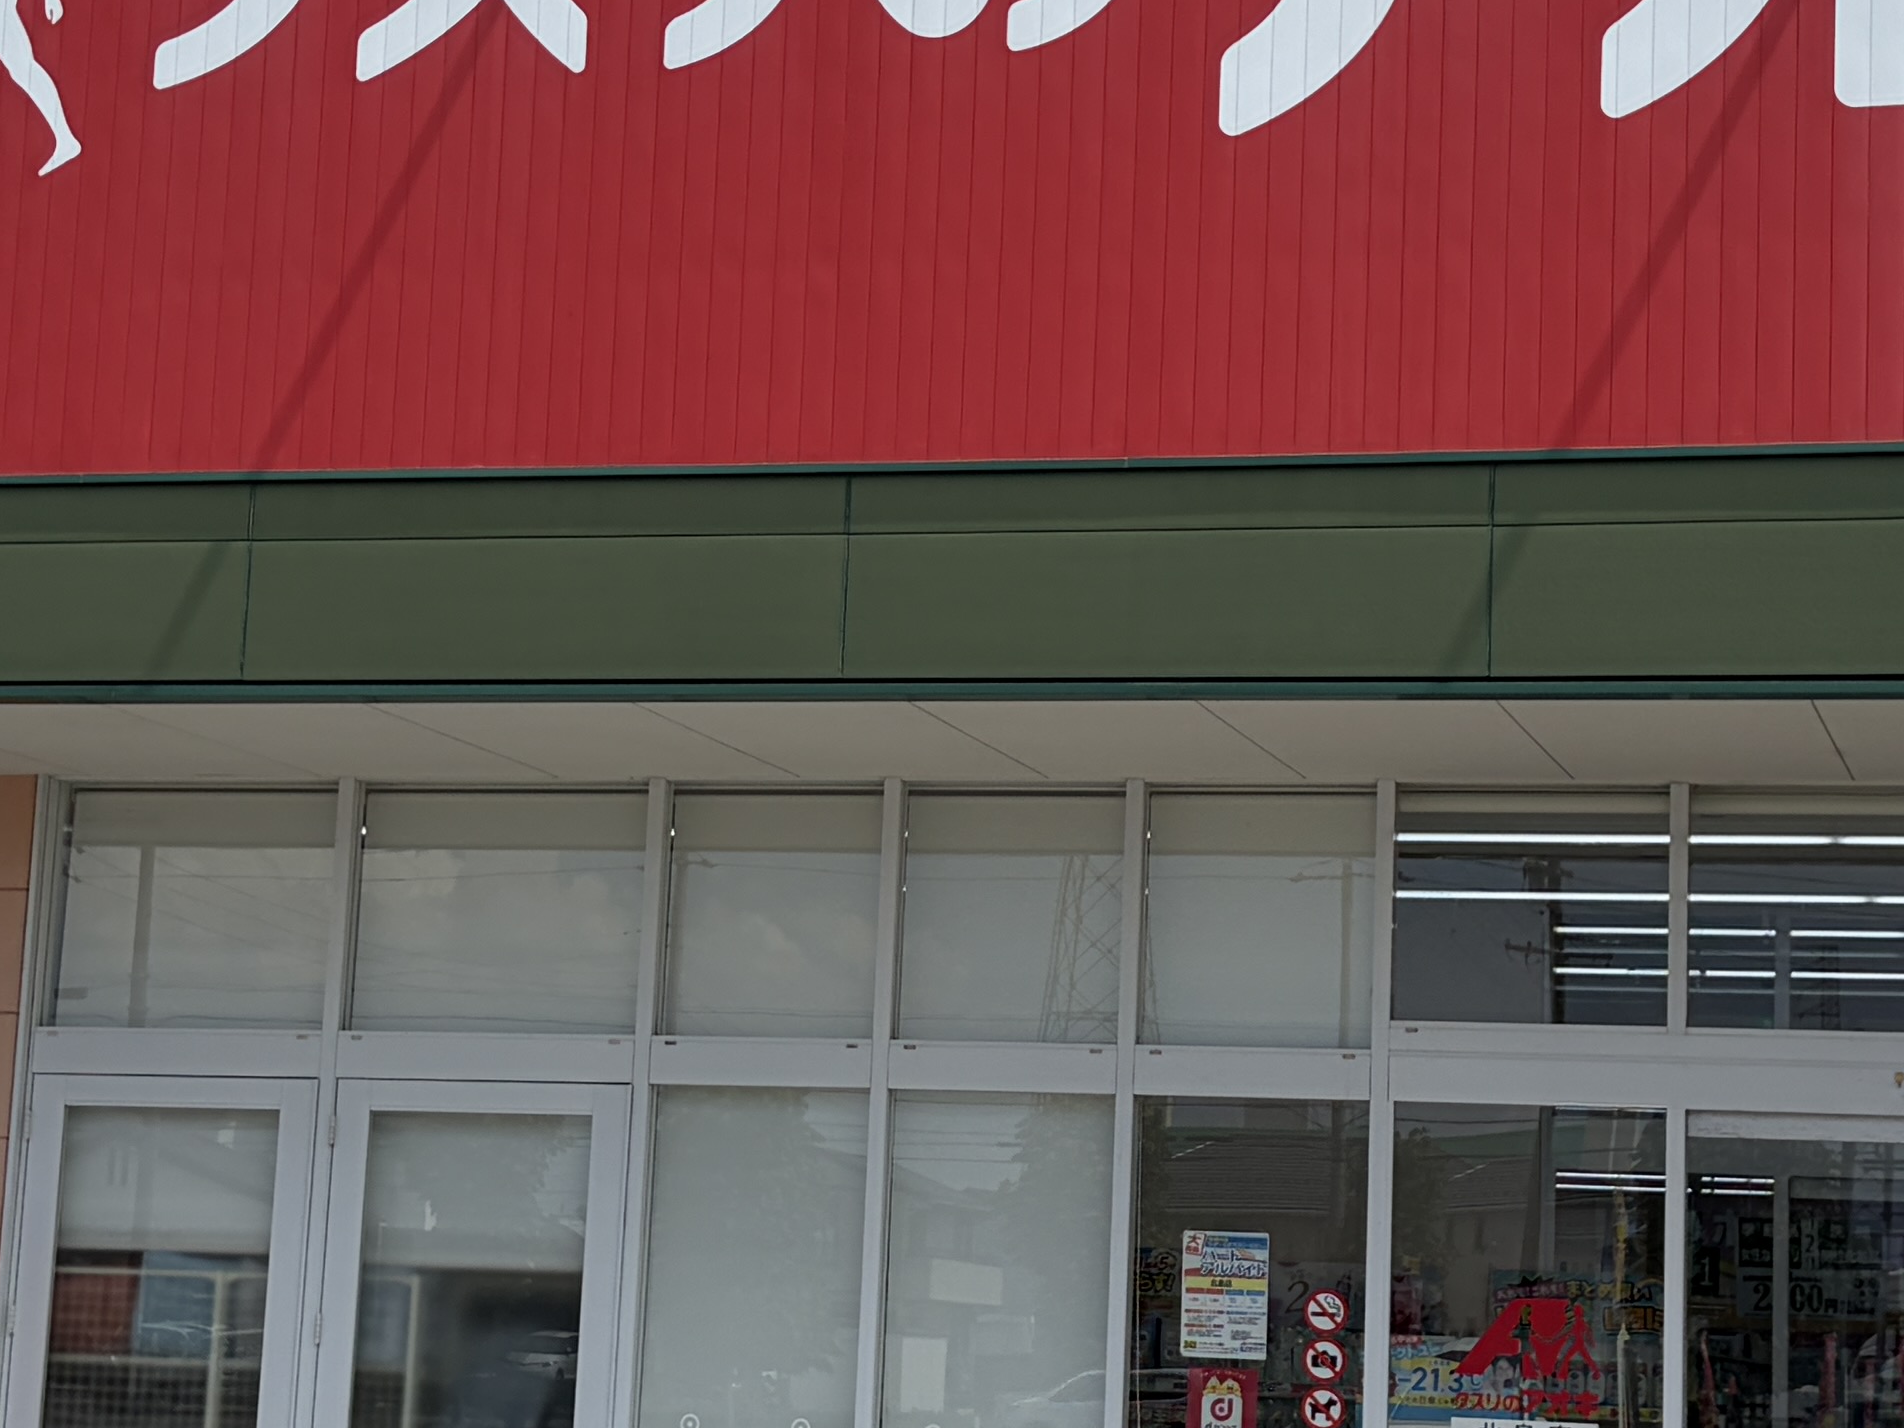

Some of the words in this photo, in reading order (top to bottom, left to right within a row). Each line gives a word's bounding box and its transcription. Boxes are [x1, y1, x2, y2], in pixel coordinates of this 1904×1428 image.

[1456, 1390, 1600, 1419] クスリのアオキ
